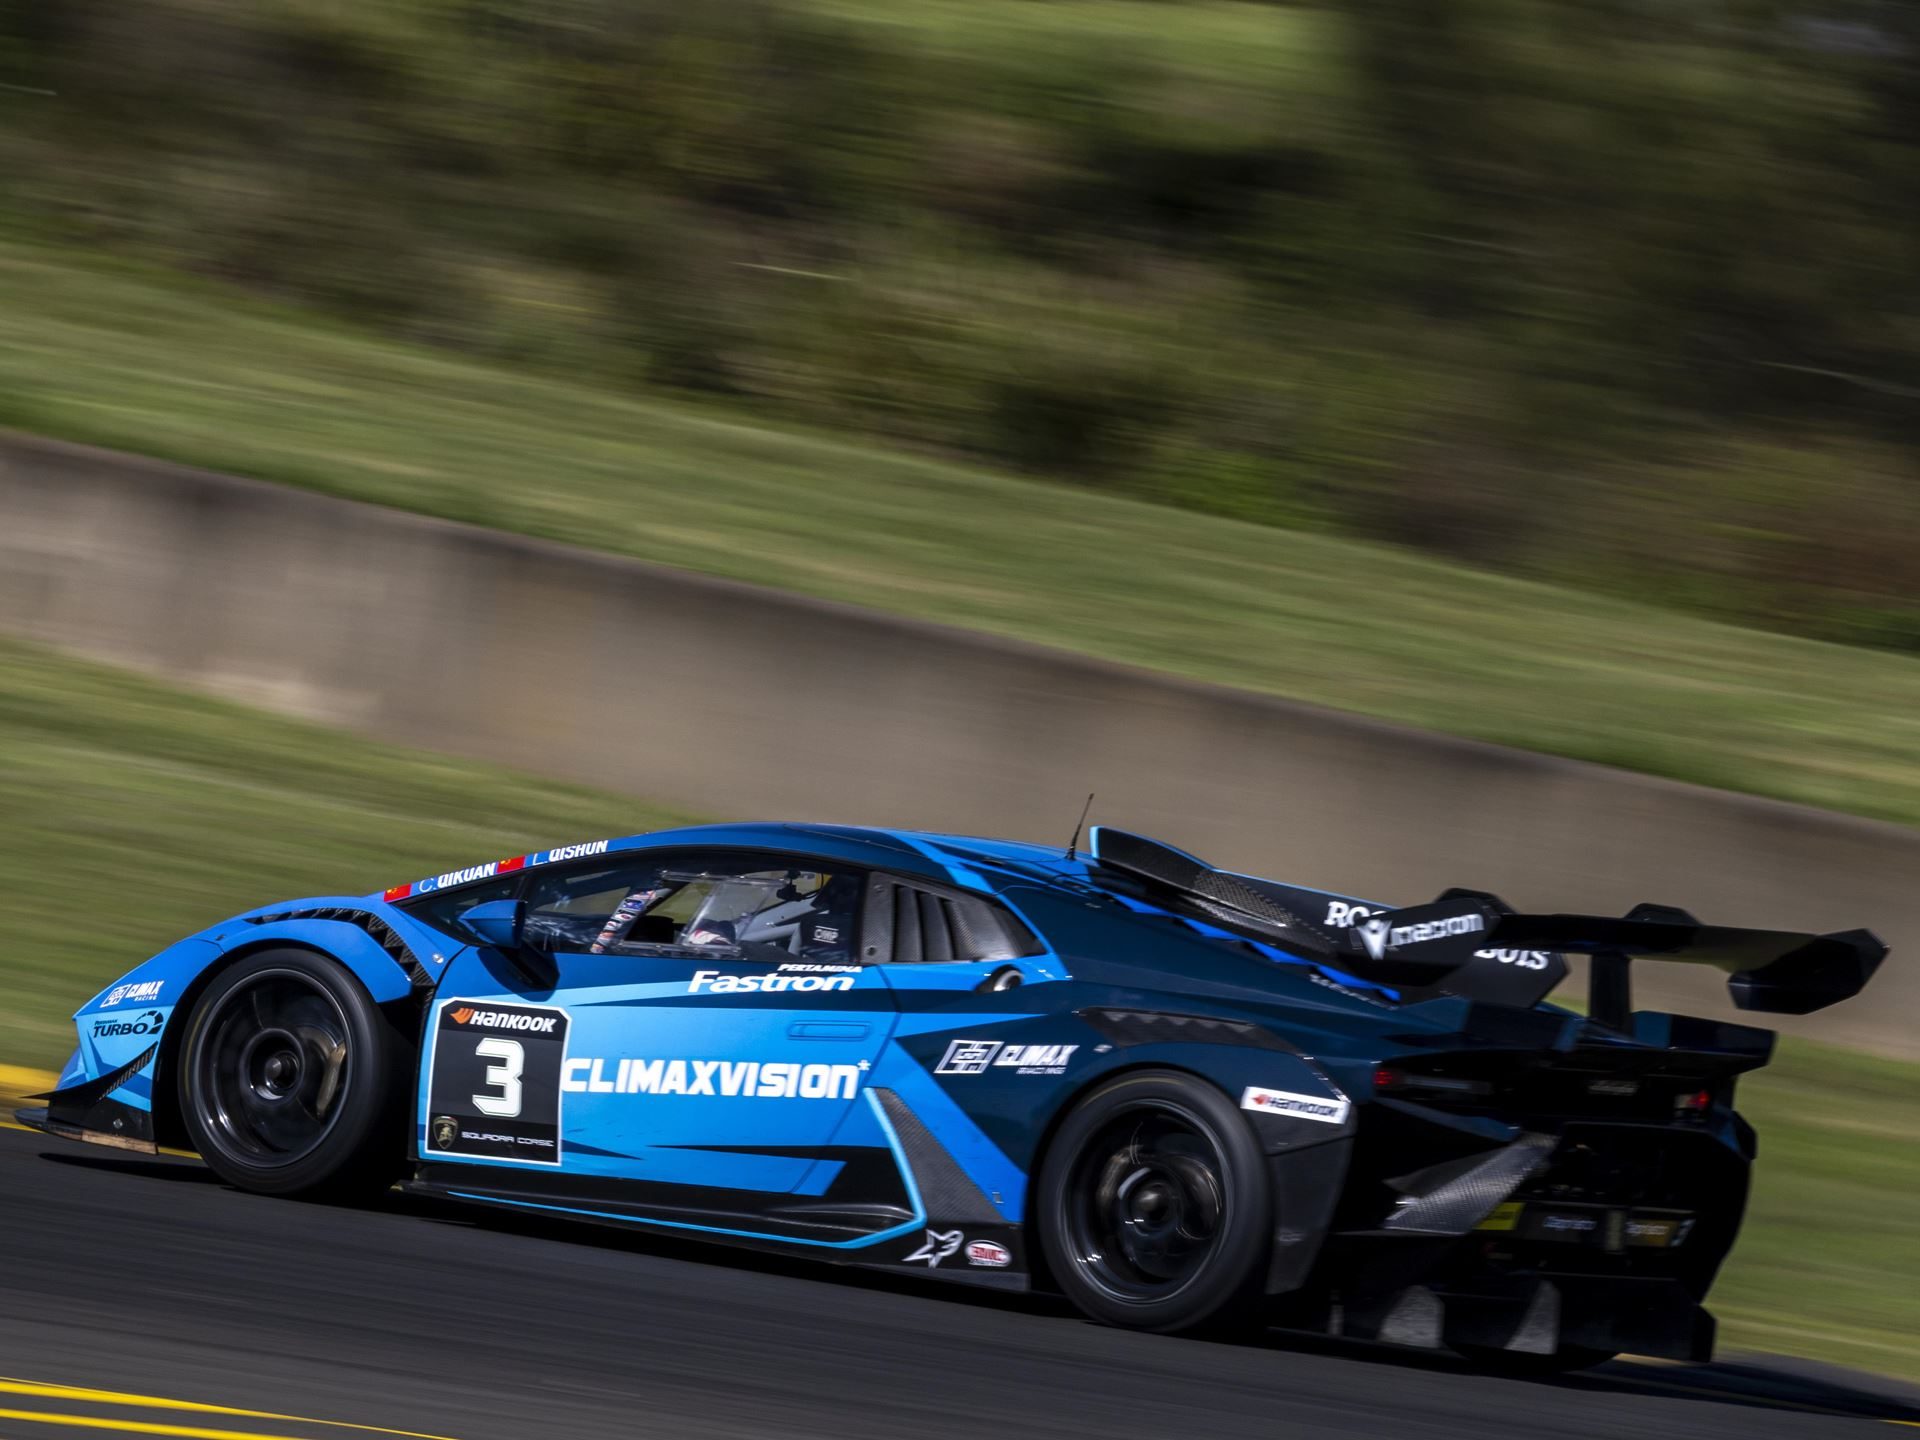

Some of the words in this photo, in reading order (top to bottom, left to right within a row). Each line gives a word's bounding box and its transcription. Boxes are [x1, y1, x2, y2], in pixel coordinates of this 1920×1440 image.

[548, 840, 609, 862] QISHUN
[437, 862, 497, 888] QIKUAN
[777, 963, 863, 973] PERTAMINA
[126, 981, 164, 998] CLIMAX
[687, 970, 855, 993] Fastron
[93, 1023, 148, 1038] TURBO
[992, 1045, 1081, 1066] CLIMAX
[472, 1037, 525, 1118] 3
[560, 1057, 862, 1100] CLIMAXVISION
